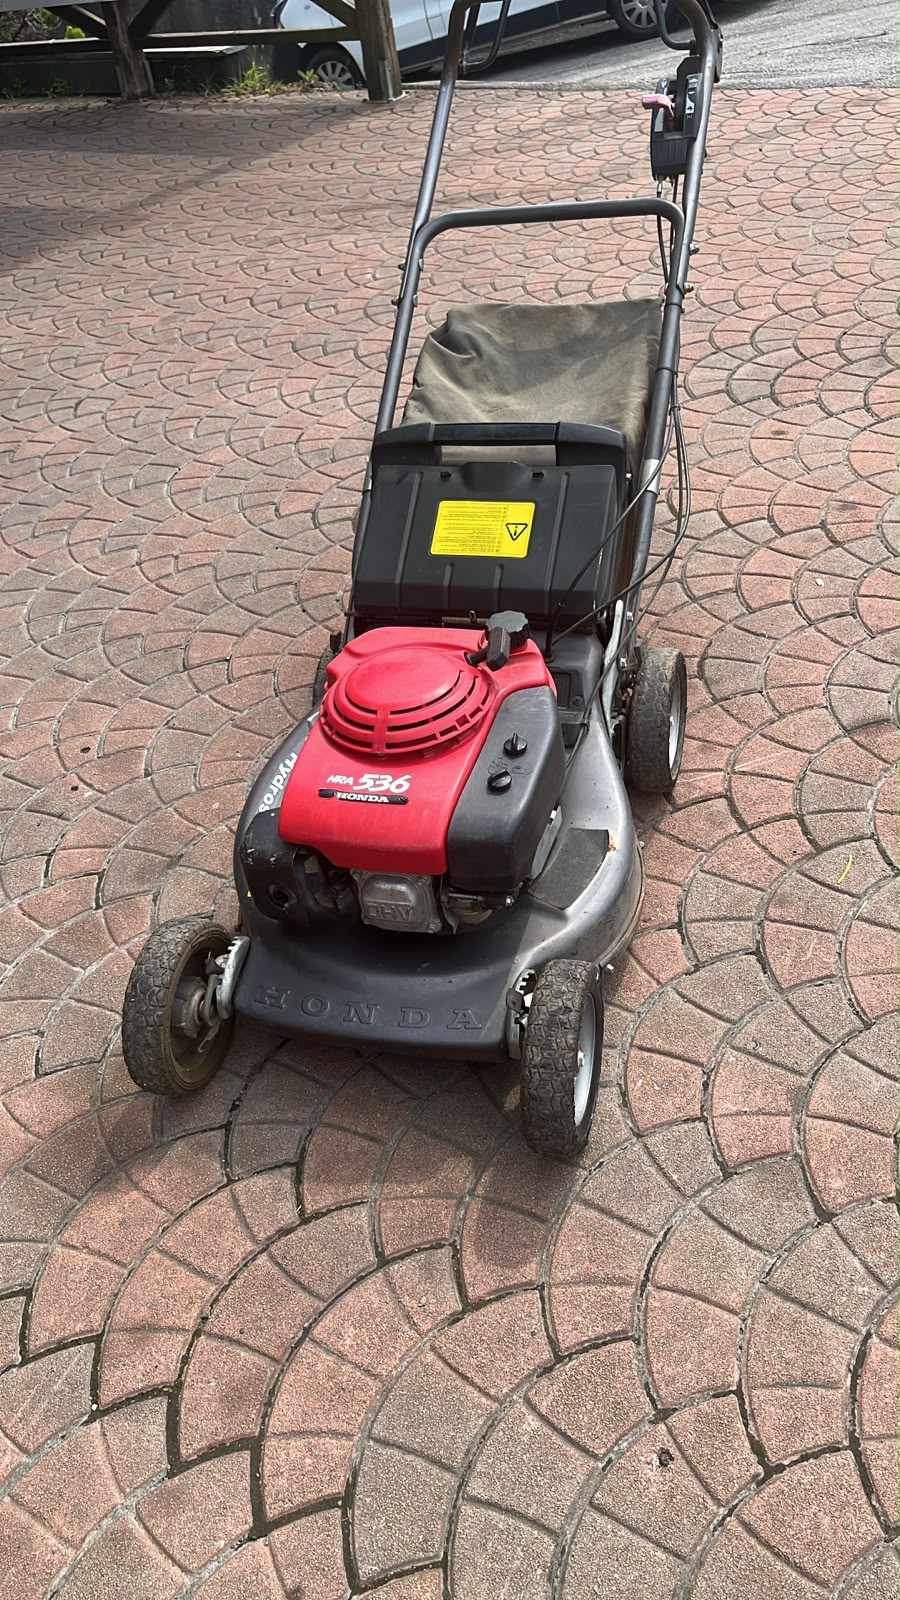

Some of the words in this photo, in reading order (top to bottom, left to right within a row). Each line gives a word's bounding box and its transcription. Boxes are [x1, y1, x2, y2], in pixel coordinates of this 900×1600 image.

[258, 752, 299, 813] Hydros
[326, 774, 354, 786] HRA
[352, 773, 413, 794] 536
[335, 791, 390, 803] HONDA
[253, 984, 483, 1030] HONDA
